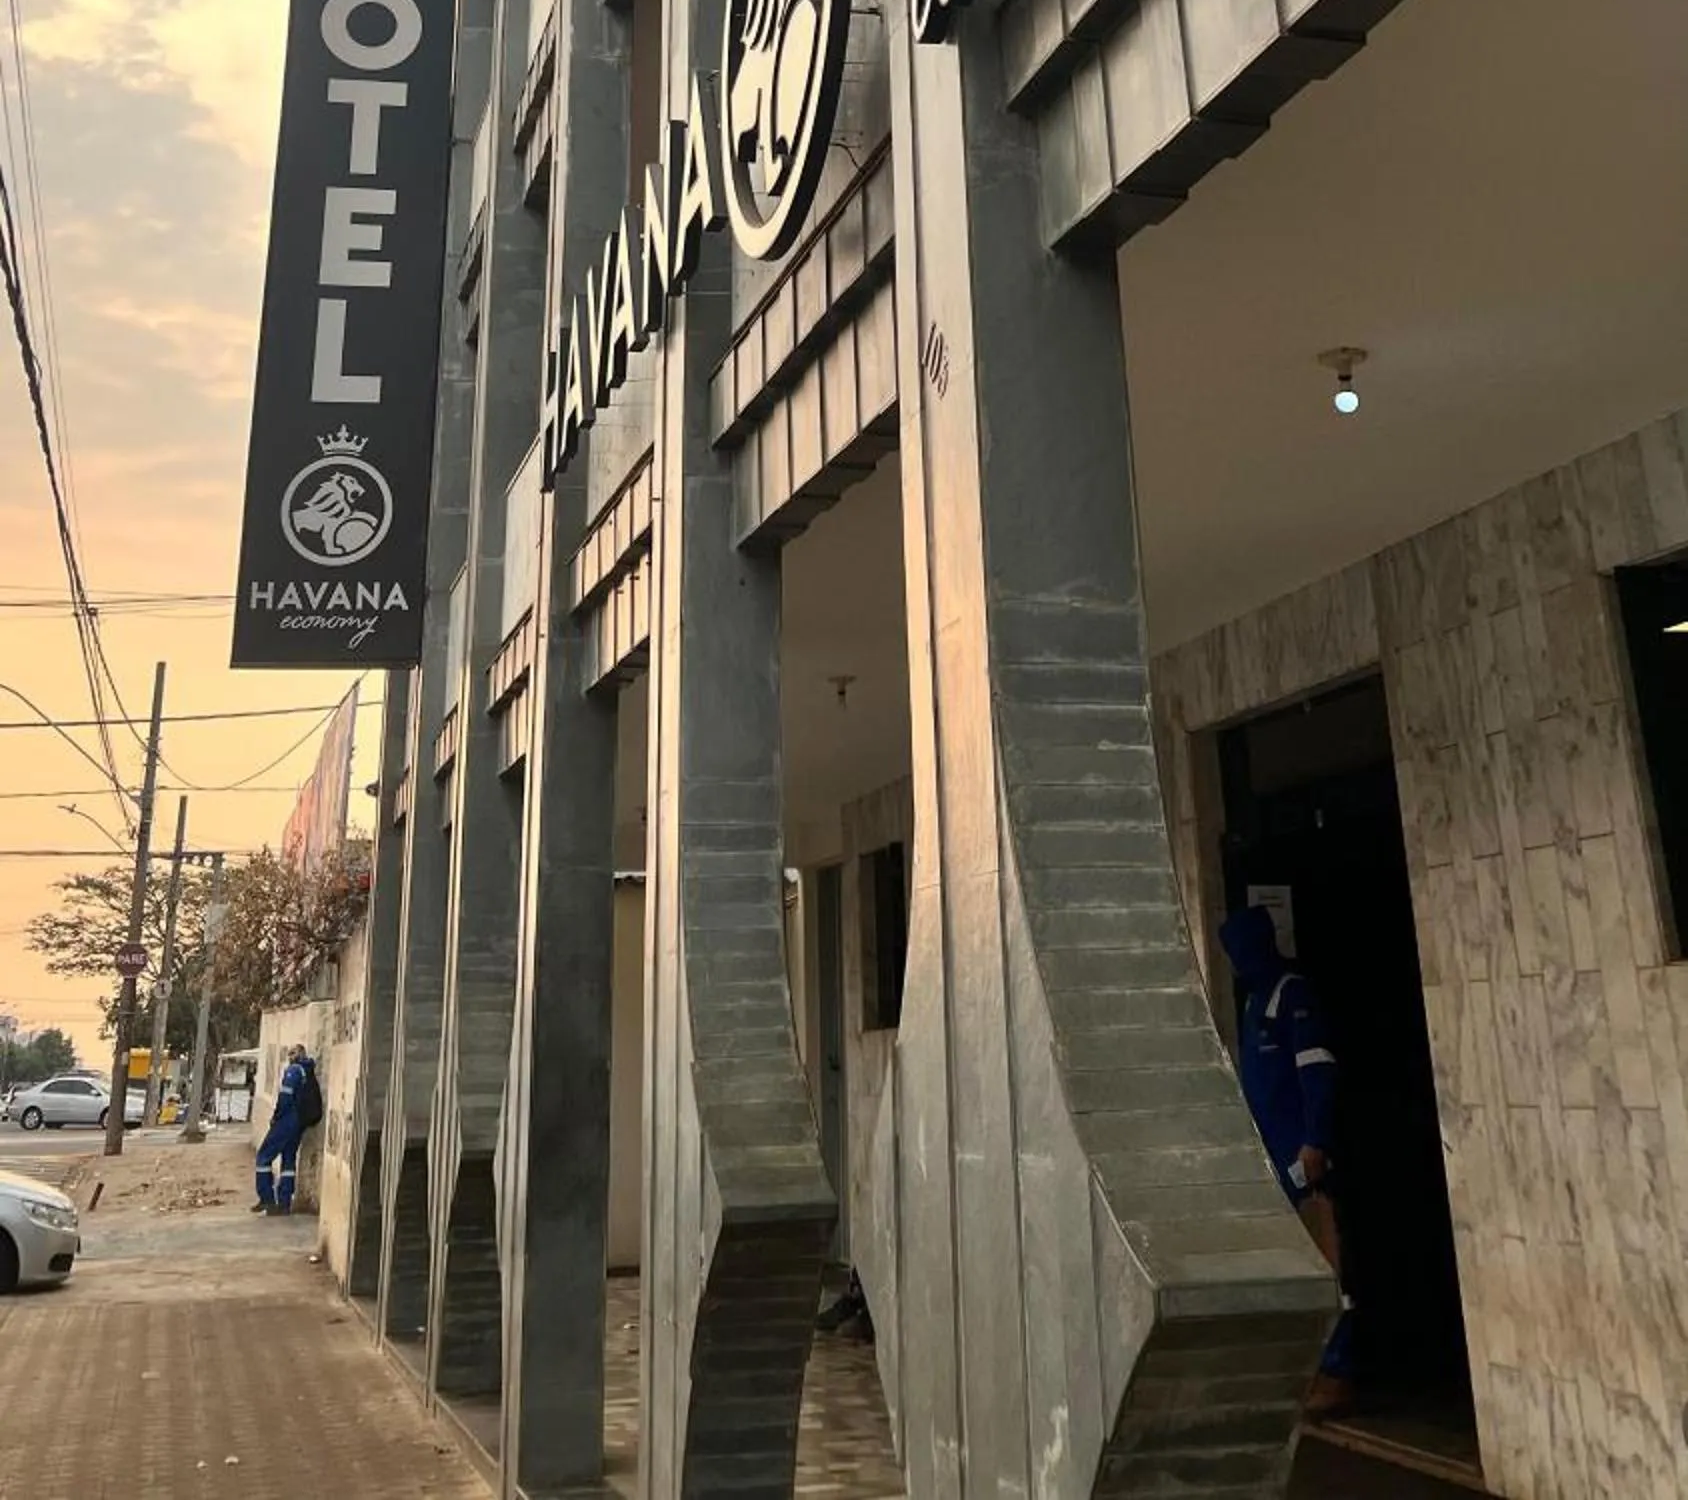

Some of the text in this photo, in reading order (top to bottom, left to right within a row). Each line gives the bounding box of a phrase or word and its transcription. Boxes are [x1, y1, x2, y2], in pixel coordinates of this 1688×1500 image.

[540, 70, 727, 491] HAVANA
[250, 580, 409, 611] HAVANA
[279, 614, 380, 650] economy
